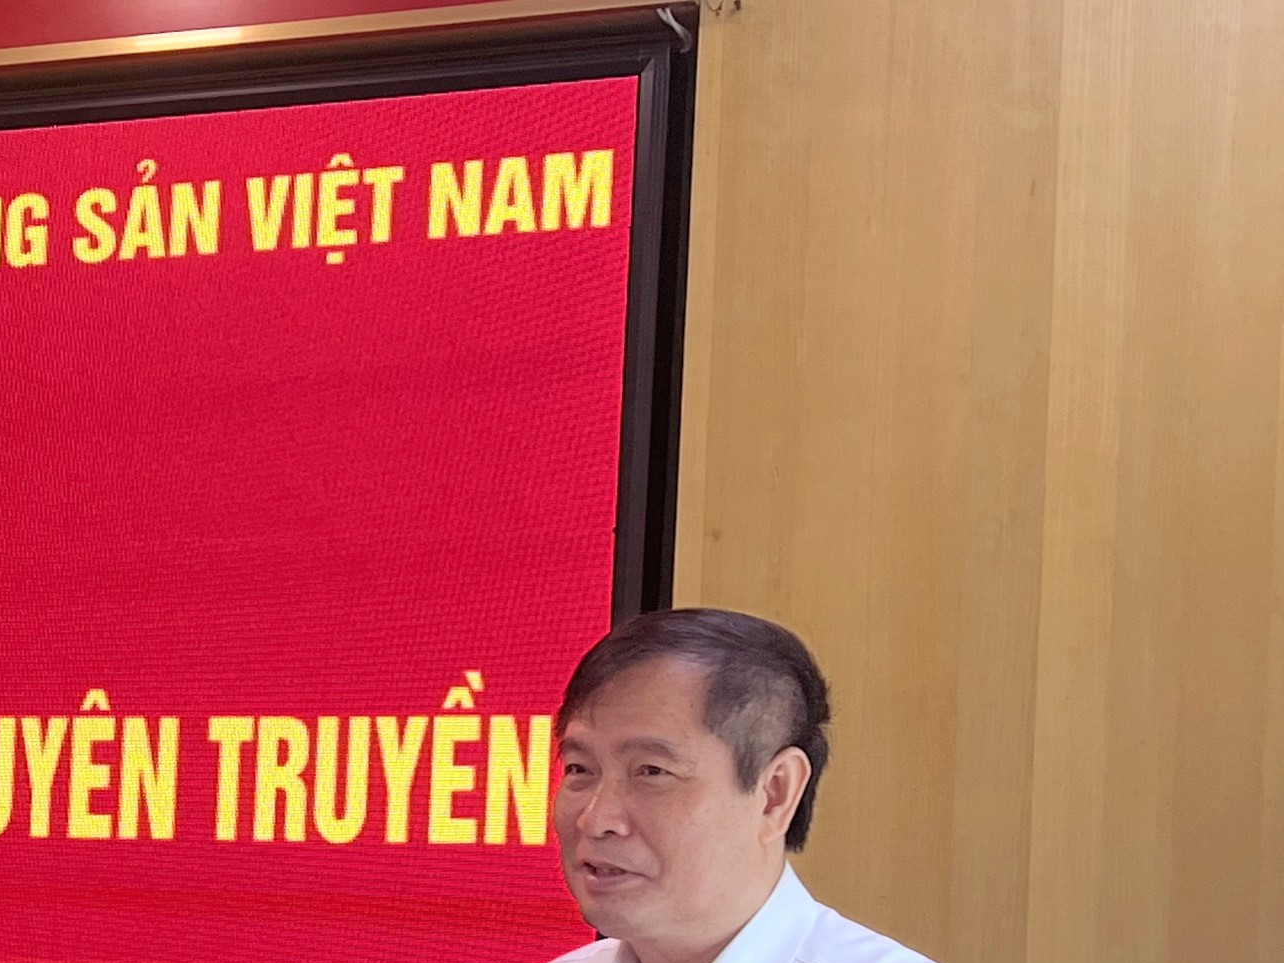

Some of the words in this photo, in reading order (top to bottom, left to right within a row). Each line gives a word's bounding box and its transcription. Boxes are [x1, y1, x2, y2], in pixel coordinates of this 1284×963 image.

[72, 159, 221, 264] SẢN
[245, 153, 405, 265] VIỆT
[426, 149, 614, 239] NAM
[208, 671, 553, 846] TRUYỀN
